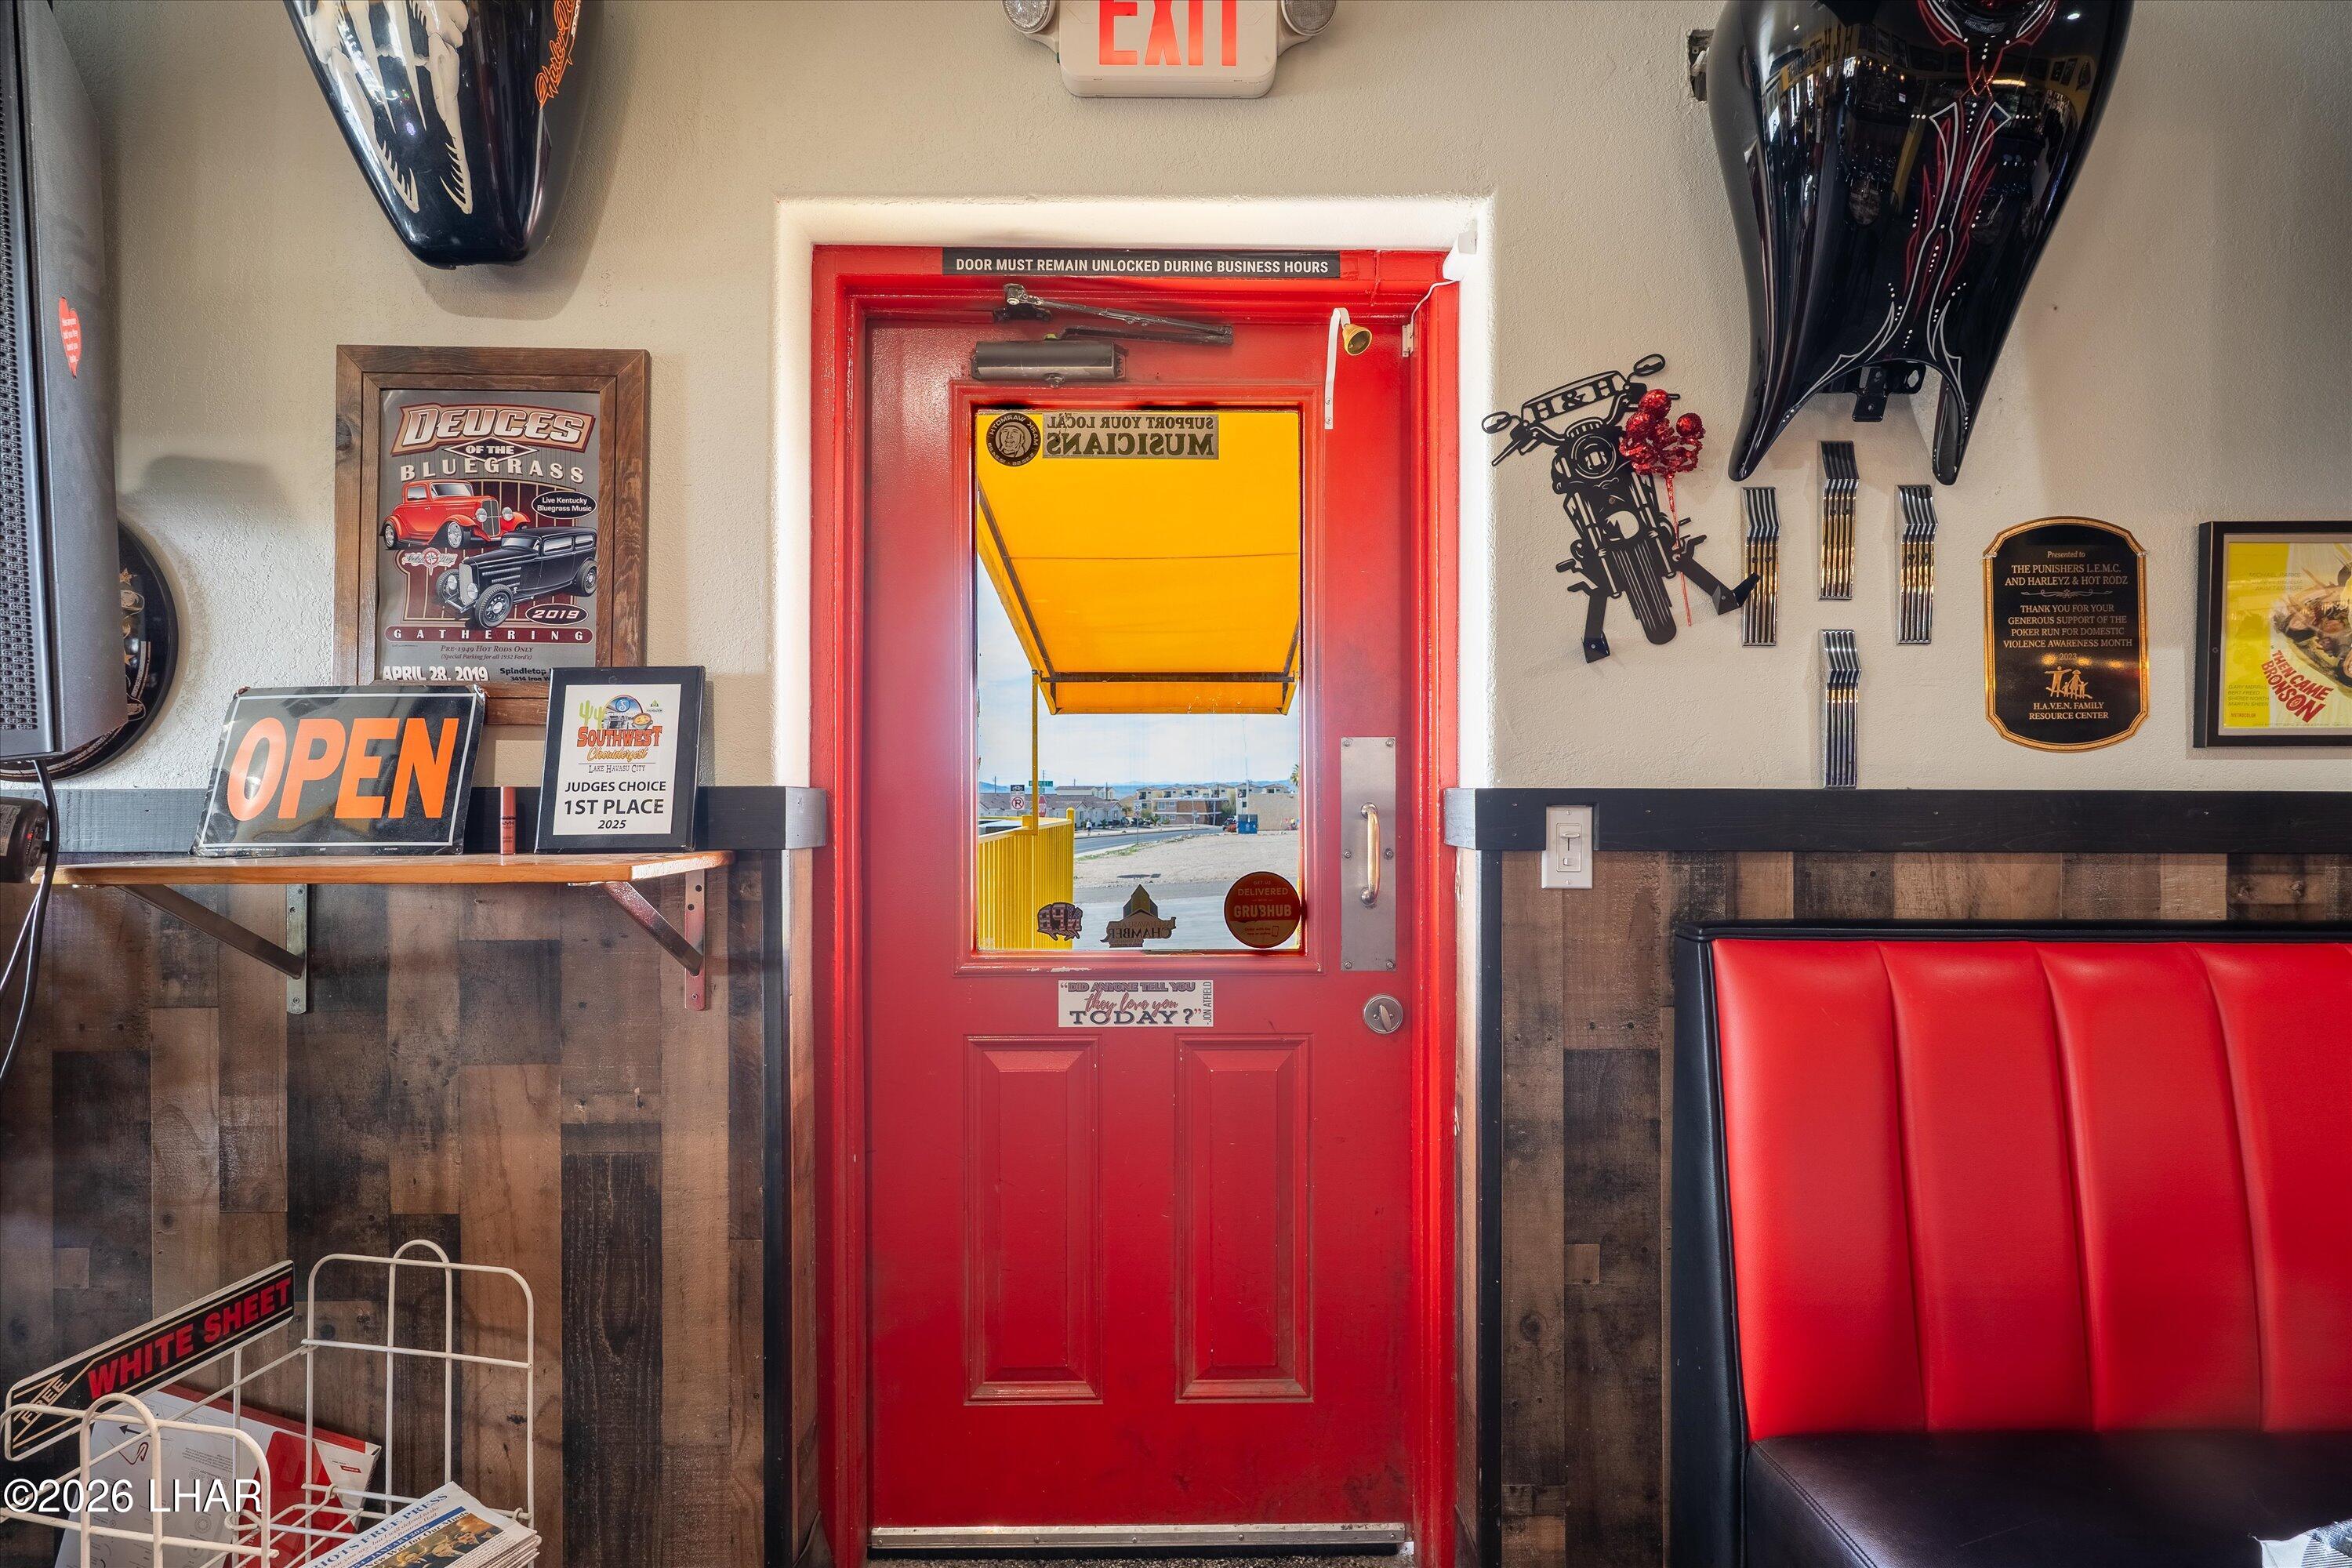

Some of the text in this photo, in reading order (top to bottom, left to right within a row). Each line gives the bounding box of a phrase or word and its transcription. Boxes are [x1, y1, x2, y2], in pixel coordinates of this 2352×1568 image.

[956, 258, 1329, 274] DOOR MUST REMAIN UNLOCKED DURING BUSINESS HOURS
[1530, 376, 1617, 424] H&H
[401, 408, 586, 447] DEUCES
[466, 445, 514, 454] OF THE
[400, 457, 585, 484] BLUEGRASS
[556, 496, 588, 506] Kentucky
[537, 504, 571, 514] Bluegrass
[2011, 564, 2122, 574] THE PUNISHERS L.E.M.C.
[2005, 575, 2129, 586] AND HARLEYZ & HOT RODZ
[532, 609, 580, 619] 2019
[2020, 604, 2051, 613] THANK
[2072, 604, 2090, 612] FOR
[2091, 604, 2114, 612] YOUR
[2008, 616, 2055, 625] GENEROUS
[2056, 615, 2095, 624] SUPPORT
[394, 629, 583, 641] GATHERING
[2011, 628, 2039, 637] POKER
[2080, 627, 2125, 636] DOMESTIC
[2003, 638, 2132, 648] VIOLENCE AWARENESS MONTH
[2058, 652, 2078, 661] 2023
[383, 666, 428, 681] APRIL
[455, 666, 490, 681] 2019
[499, 667, 547, 676] Spindletop
[2272, 649, 2335, 701] THEN CAME
[2260, 659, 2326, 723] BRONSON
[577, 725, 663, 748] SOUTHWEST
[586, 746, 648, 763] Chowderfest
[227, 717, 459, 822] OPEN
[588, 764, 646, 774] LAKE HAVASU CITY
[564, 781, 666, 793] JUDGES CHOICE
[564, 798, 664, 815] 1ST PLACE
[597, 819, 627, 829] 2025
[1237, 887, 1289, 896] DELIVERED
[1233, 904, 1292, 918] GRUBHUB
[1091, 982, 1139, 993] ANYONE
[1140, 982, 1169, 993] TELL
[1169, 982, 1196, 993] YOU
[1203, 982, 1212, 1008] ATFIELD
[1084, 989, 1178, 1018] they love you
[20, 1276, 292, 1425] FREE WHITE SHEET
[361, 1519, 402, 1544] FREE
[403, 1493, 448, 1519] PRESS
[387, 1544, 408, 1557] War
[408, 1536, 423, 1547] for
[423, 1526, 441, 1537] Our
[442, 1511, 470, 1527] Minds
[370, 1533, 408, 1560] JANUARY
[408, 1525, 430, 1538] 2026
